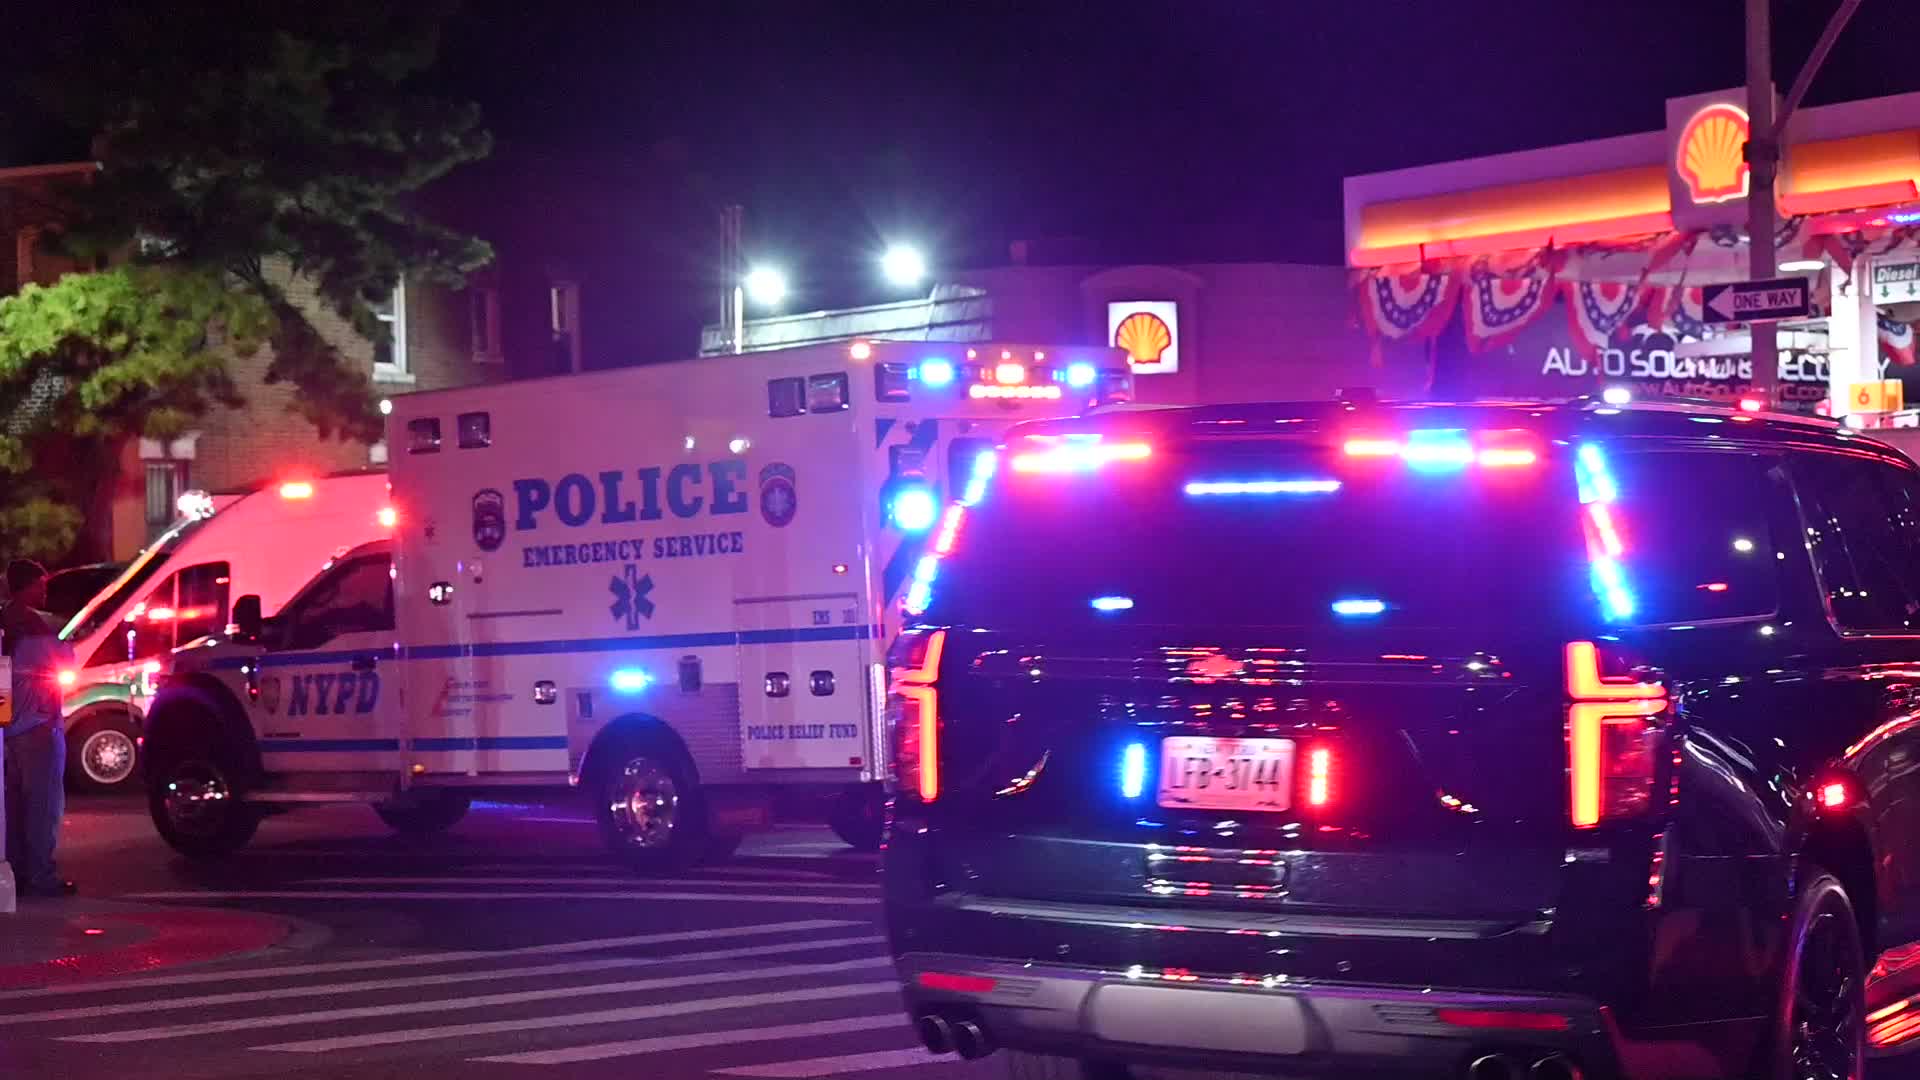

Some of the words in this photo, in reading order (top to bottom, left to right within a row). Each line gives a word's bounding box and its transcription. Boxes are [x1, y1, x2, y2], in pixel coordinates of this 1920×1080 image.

[1877, 264, 1918, 282] Diesel
[1733, 294, 1761, 309] ONE
[1767, 290, 1798, 306] WAY
[1857, 387, 1871, 406] 6
[513, 460, 748, 531] POLICE
[522, 538, 643, 568] EMERGENCY
[653, 531, 744, 559] SERVICE
[287, 671, 380, 717] NYPD
[748, 725, 784, 740] POLICE
[788, 724, 825, 739] RELIEF
[829, 723, 858, 738] FUND
